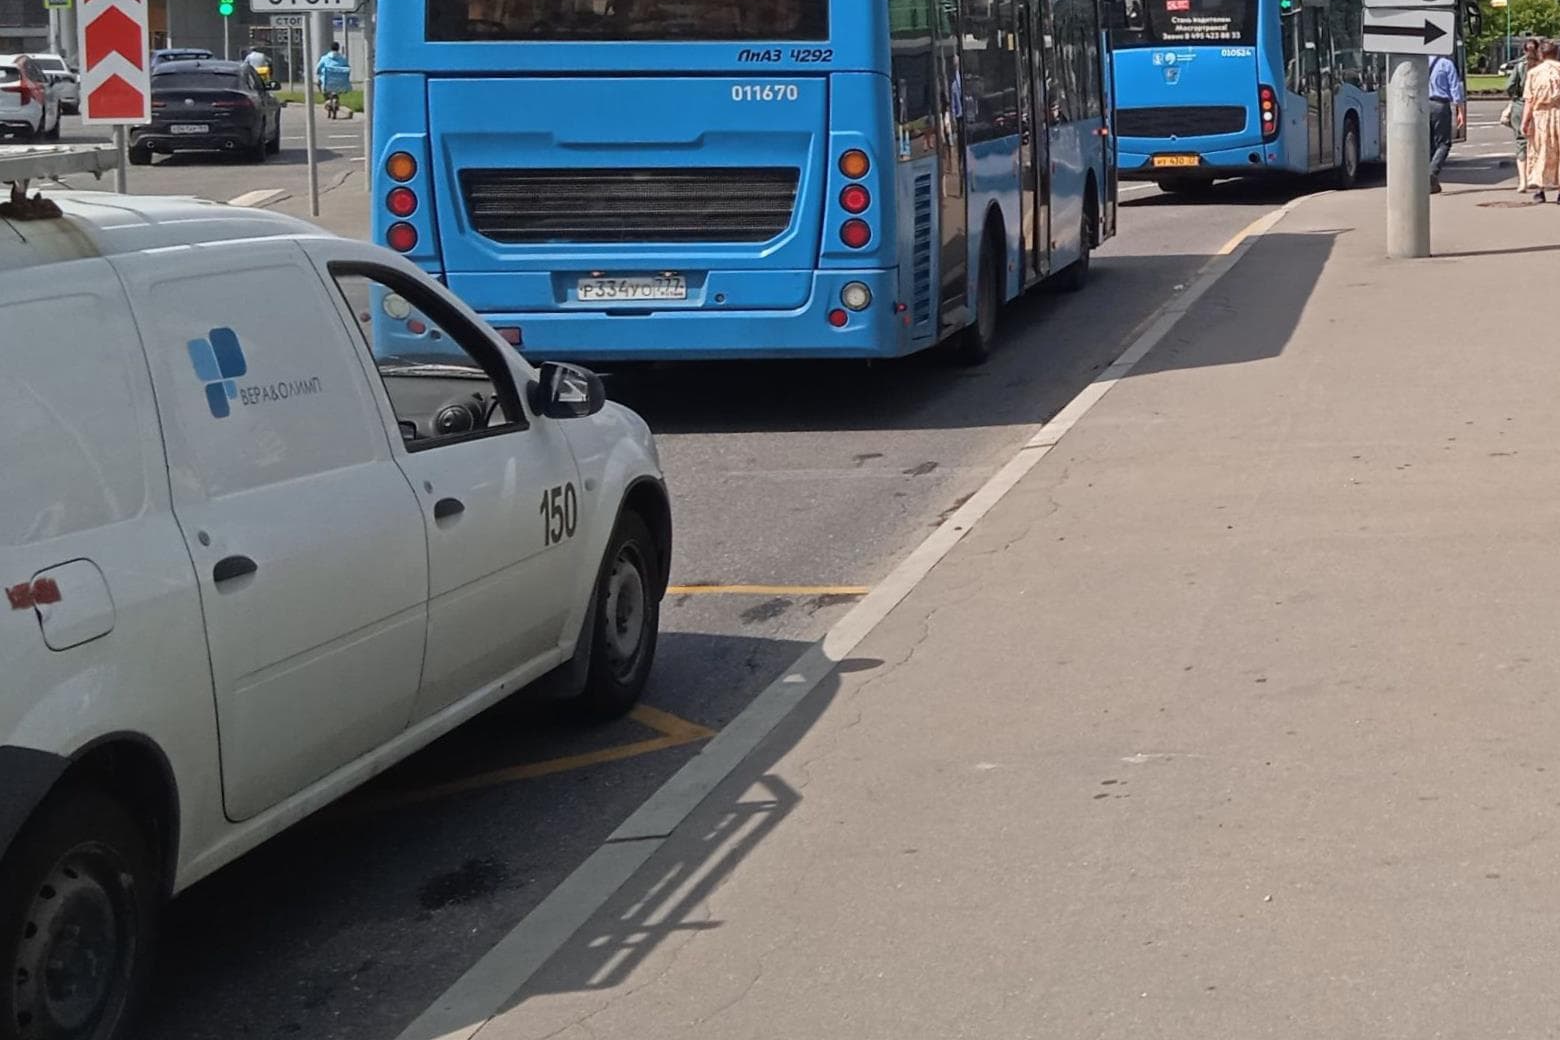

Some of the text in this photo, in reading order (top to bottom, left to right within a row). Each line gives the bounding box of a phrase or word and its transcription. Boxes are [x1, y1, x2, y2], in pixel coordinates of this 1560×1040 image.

[790, 49, 833, 62] 4292
[732, 85, 798, 101] 011670
[540, 482, 577, 546] 150
